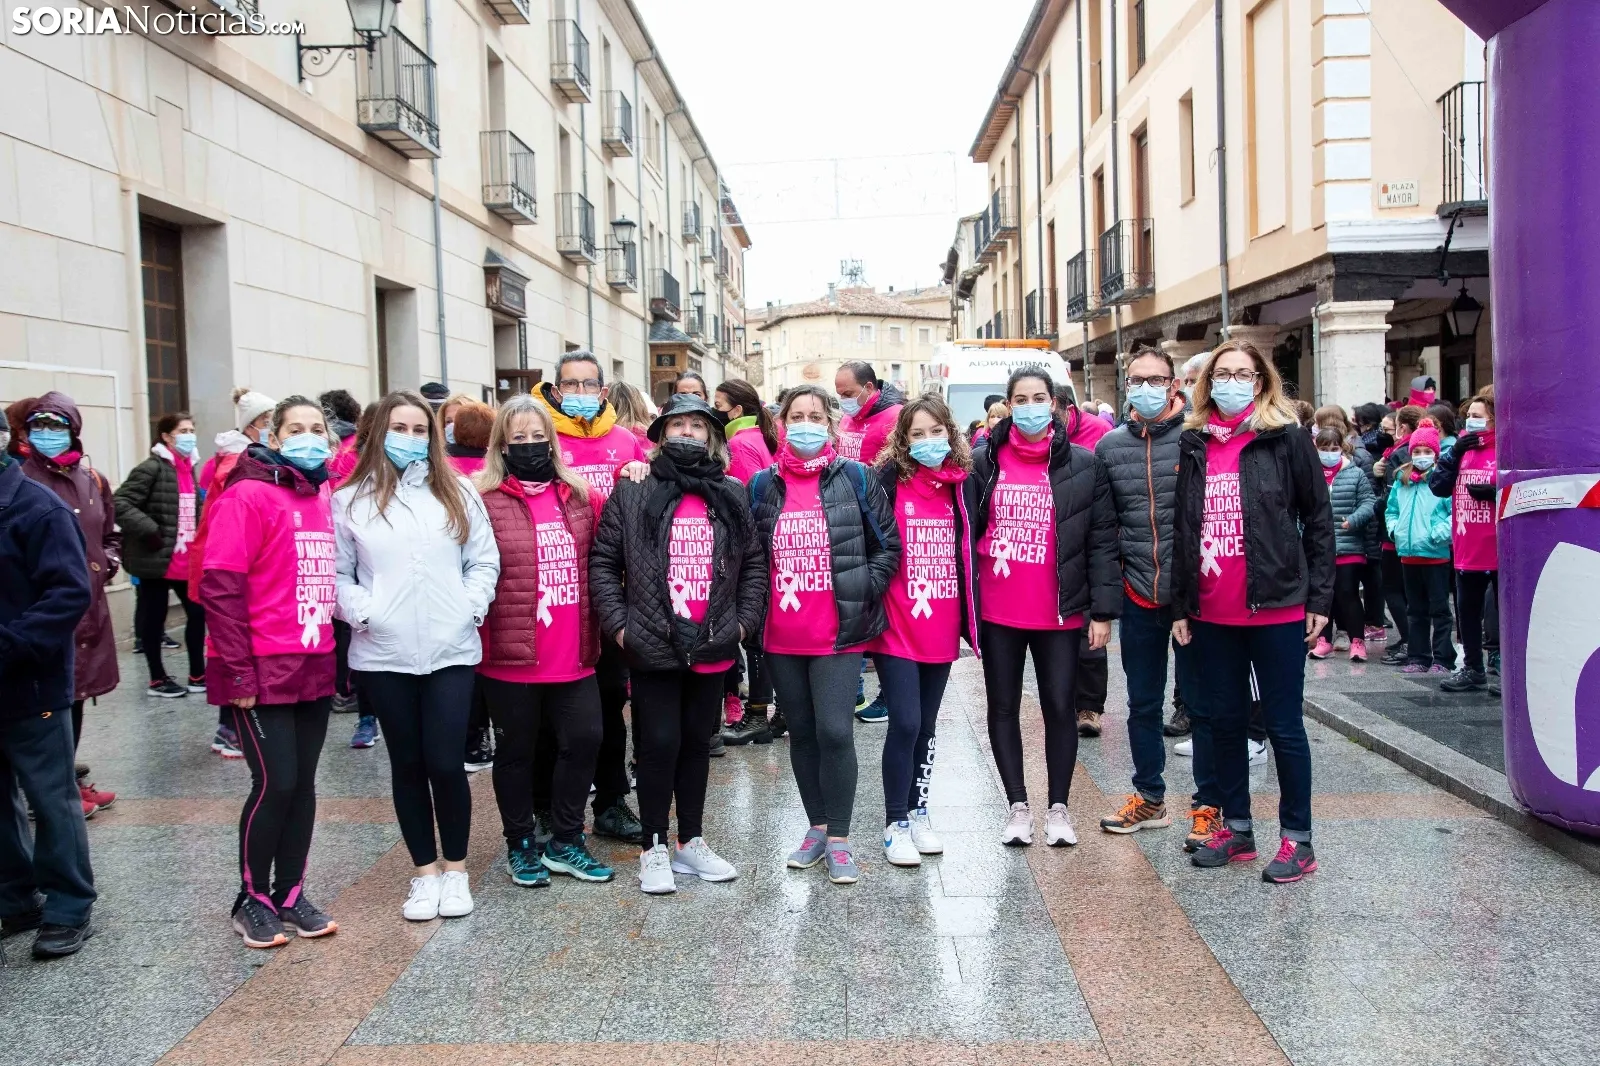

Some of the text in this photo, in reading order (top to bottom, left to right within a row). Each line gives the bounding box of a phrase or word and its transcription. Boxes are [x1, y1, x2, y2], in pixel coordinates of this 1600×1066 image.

[1391, 183, 1415, 191] PLAZA
[1386, 193, 1412, 204] MAYOR
[1002, 491, 1053, 509] MARCHA
[1481, 500, 1490, 510] EL
[995, 506, 1051, 523] SOLIDARIA
[1455, 510, 1491, 524] CNCER
[671, 524, 714, 541] MARCH
[906, 527, 914, 543] II
[992, 526, 1032, 543] CONTRA
[1034, 530, 1048, 545] EL
[1202, 519, 1237, 536] ONTRA
[772, 533, 830, 551] SOLIDARIA
[689, 556, 698, 564] DE
[797, 549, 805, 557] DE
[806, 548, 821, 556] OSMA
[989, 540, 1047, 565] CNCER
[774, 555, 831, 573] CONTRA EL
[931, 557, 939, 565] DE
[668, 564, 709, 580] ONTRA
[907, 564, 958, 580] CONTRA EL
[775, 571, 833, 593] CNCER
[907, 579, 959, 600] CNCER
